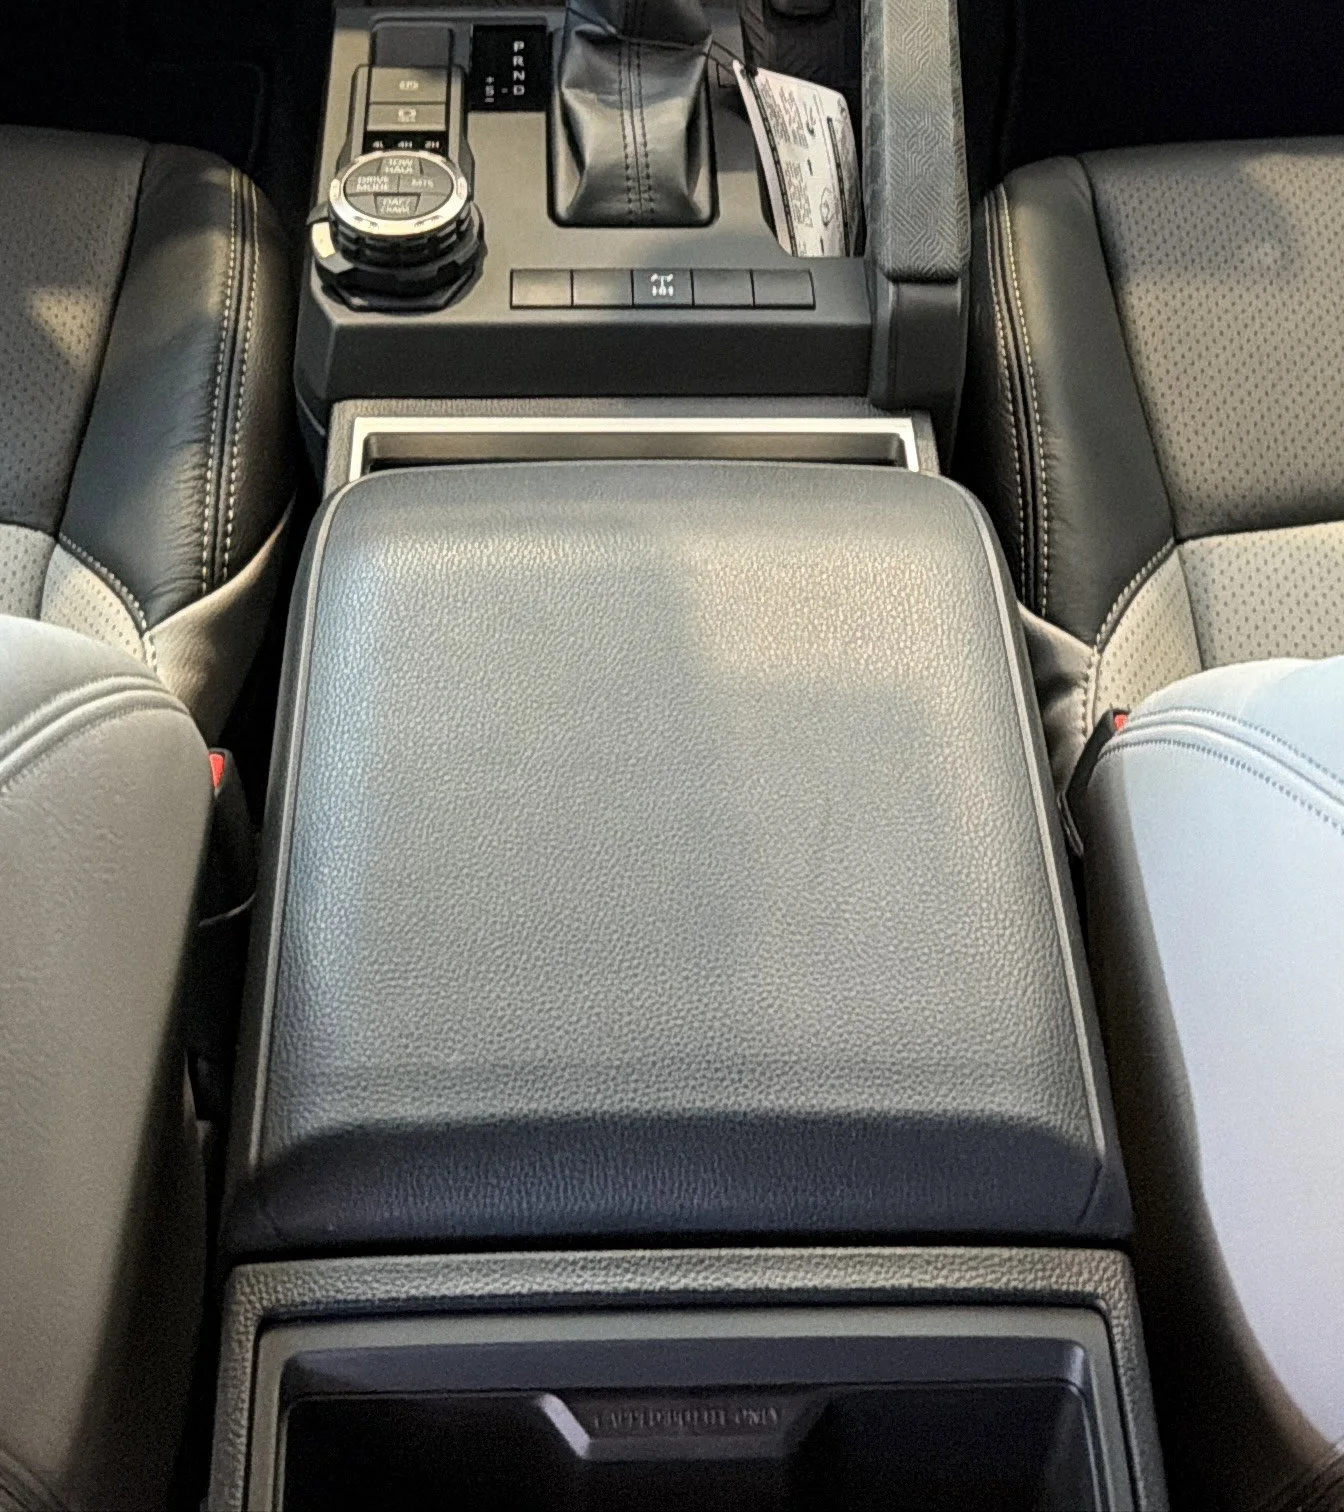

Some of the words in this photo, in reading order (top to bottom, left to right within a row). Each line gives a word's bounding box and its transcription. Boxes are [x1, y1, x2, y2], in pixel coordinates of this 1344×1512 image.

[513, 40, 525, 53] P
[513, 55, 524, 67] R
[513, 70, 525, 81] N
[513, 84, 525, 96] D
[397, 140, 413, 148] 4H
[424, 140, 440, 148] 2H
